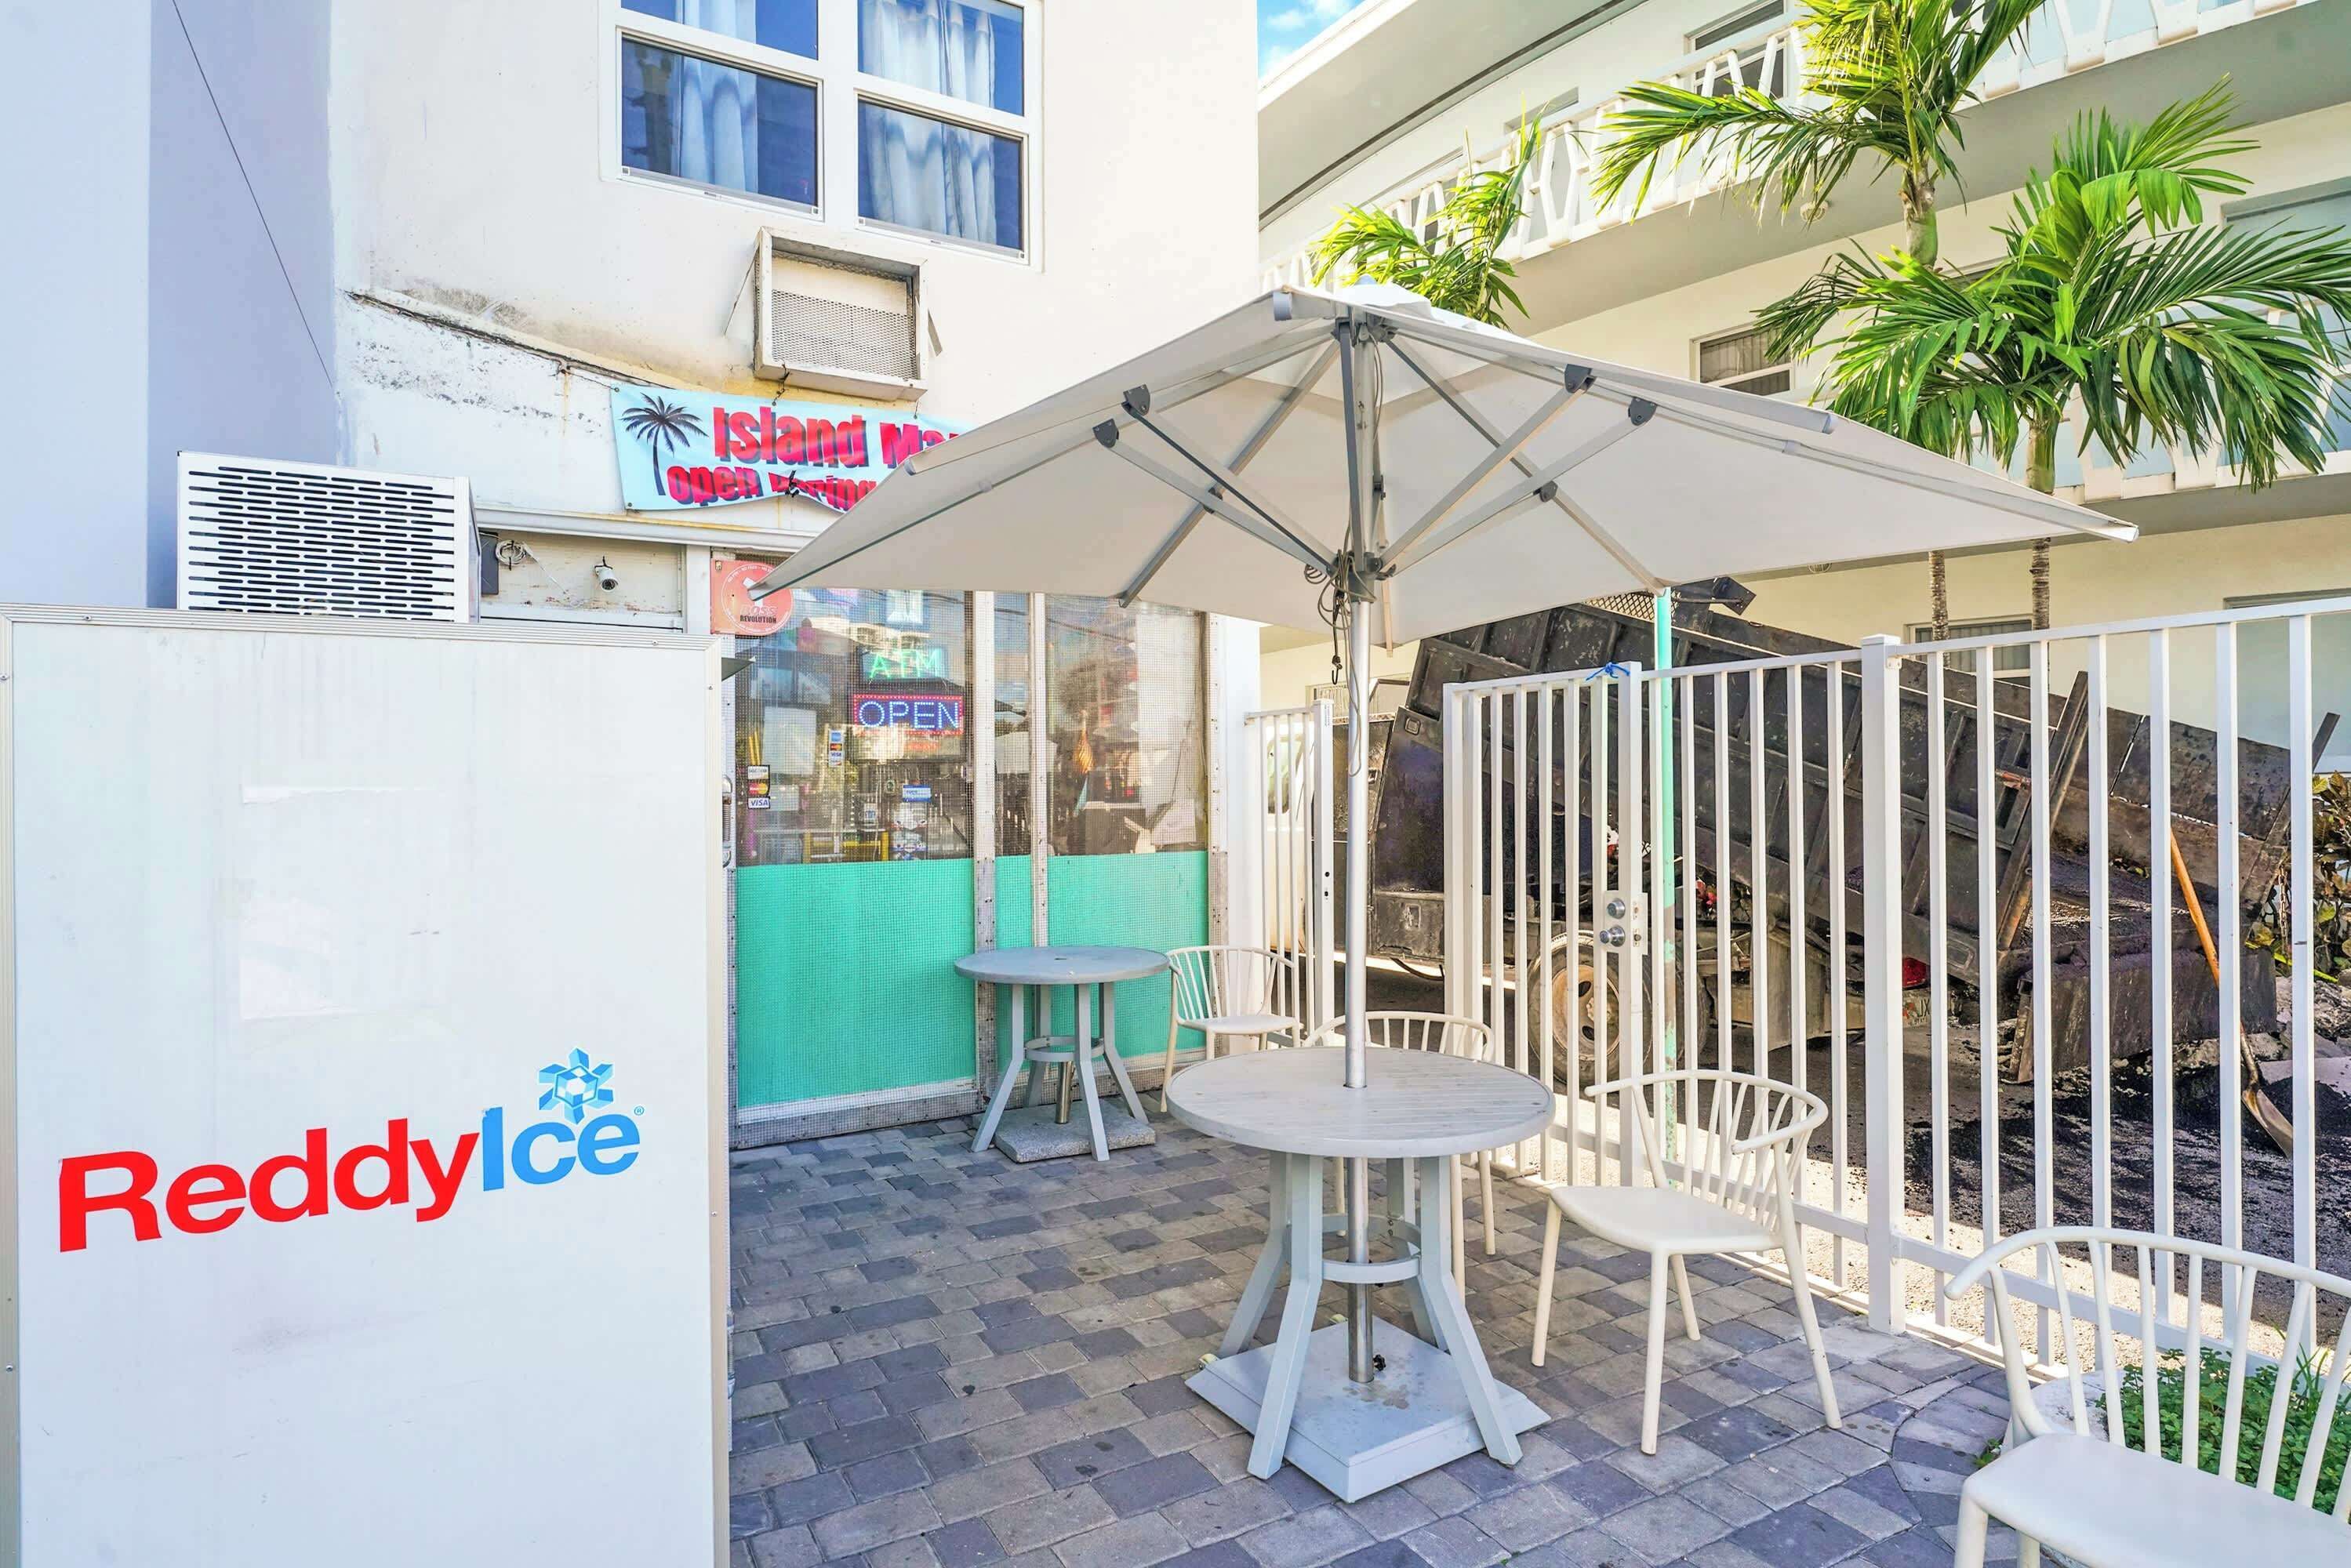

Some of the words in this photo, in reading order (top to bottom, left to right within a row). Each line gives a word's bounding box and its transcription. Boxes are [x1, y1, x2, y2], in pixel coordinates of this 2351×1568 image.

[713, 406, 868, 467] Island
[667, 466, 764, 505] open
[739, 615, 776, 624] REVOLUTION
[869, 648, 939, 678] ATM
[859, 700, 958, 728] OPEN
